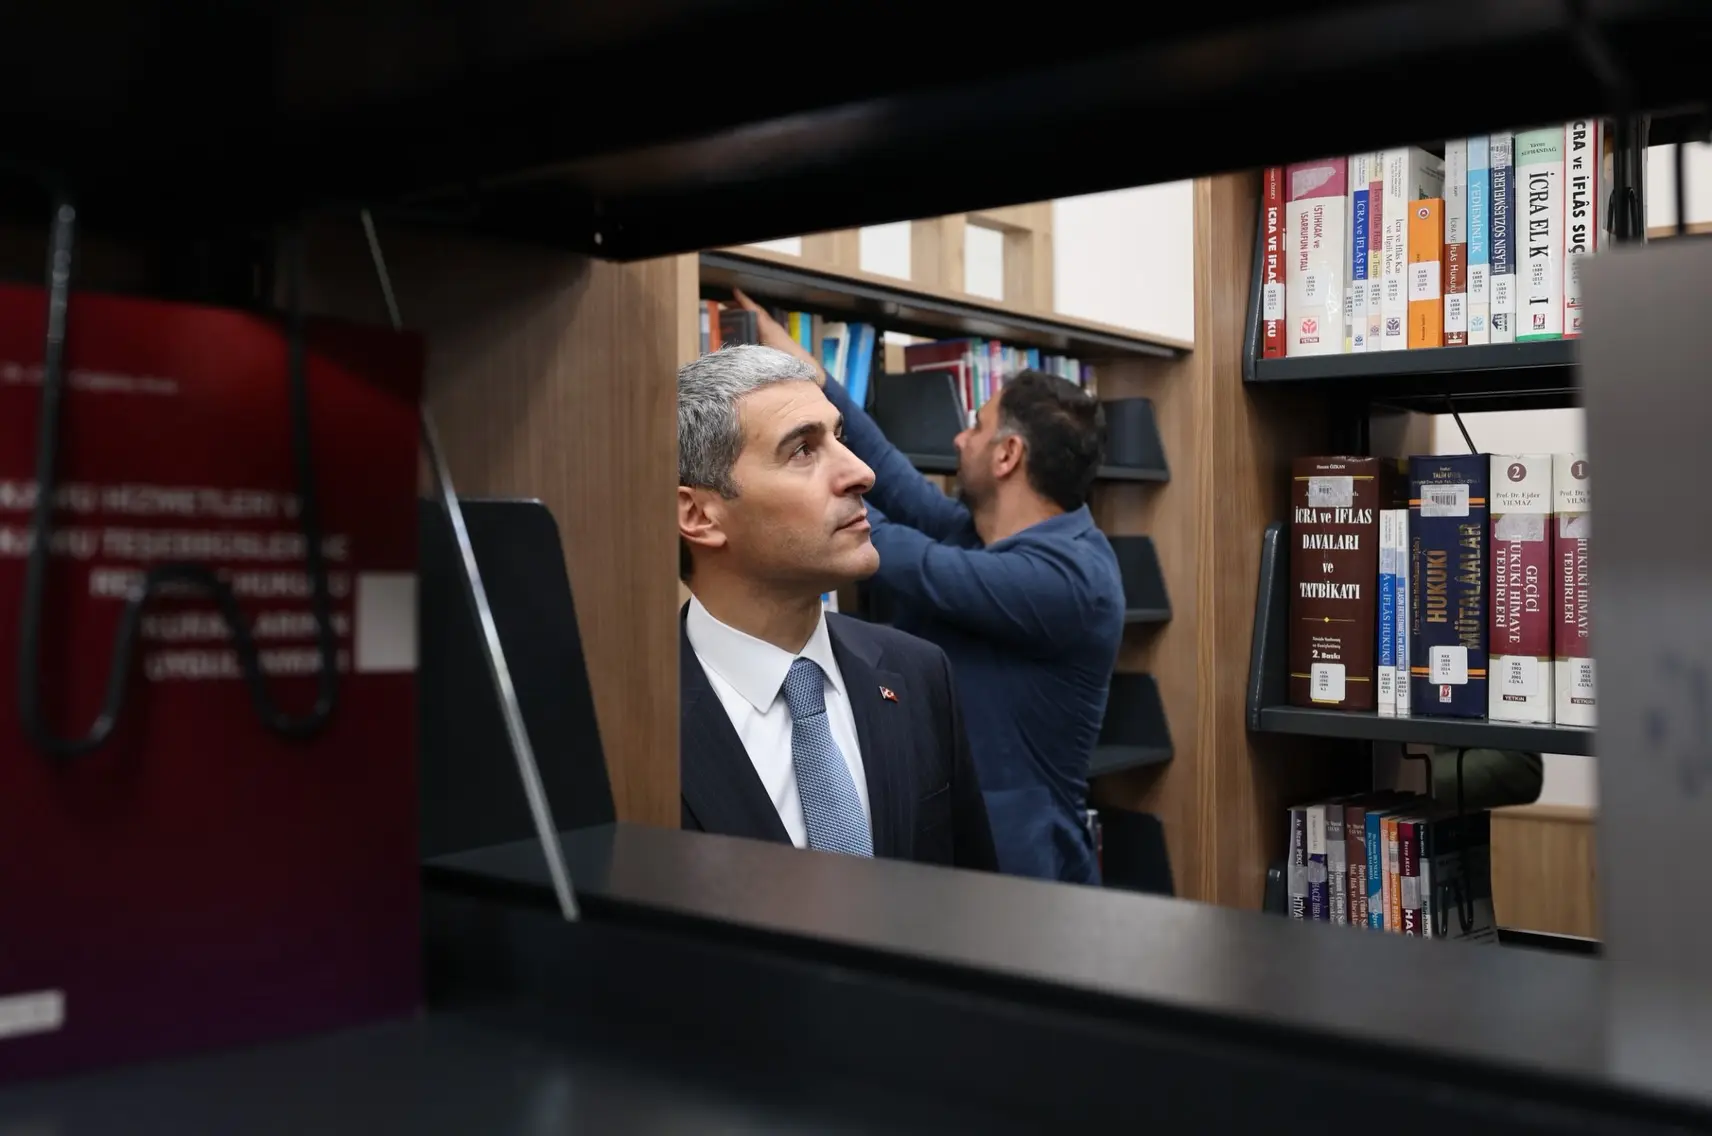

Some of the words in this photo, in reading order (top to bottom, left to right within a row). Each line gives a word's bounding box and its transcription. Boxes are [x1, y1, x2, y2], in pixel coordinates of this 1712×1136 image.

[1573, 156, 1582, 170] VE
[1529, 171, 1555, 215] İCRA
[1572, 176, 1590, 218] İFLÂS
[1267, 206, 1278, 234] İCRA
[1356, 199, 1367, 224] İCRA
[1471, 181, 1483, 254] YEDİEMİNLİK
[1356, 224, 1363, 235] ve
[1529, 218, 1549, 243] EL
[1268, 235, 1277, 252] VE
[1512, 465, 1521, 479] 2
[1576, 463, 1583, 477] 1
[1295, 505, 1318, 524] İCRA
[1320, 512, 1332, 524] ve
[1334, 505, 1373, 524] İFLAS
[1302, 534, 1360, 550] DAVALARI
[1322, 562, 1334, 574] ve
[1510, 535, 1524, 587] HUKUKİ
[1299, 580, 1361, 600] TATBİKATI
[1383, 582, 1389, 592] ve
[1495, 547, 1508, 628] TEDBİRLERİ
[1523, 565, 1540, 612] GEÇİCİ
[1564, 551, 1576, 624] TEDBİRLERİ
[1383, 593, 1393, 621] İFLÂS
[1509, 590, 1523, 643] HİMAYE
[1578, 589, 1590, 638] HİMAYE
[1312, 650, 1321, 659] 2.
[1382, 622, 1391, 665] HUKUKU
